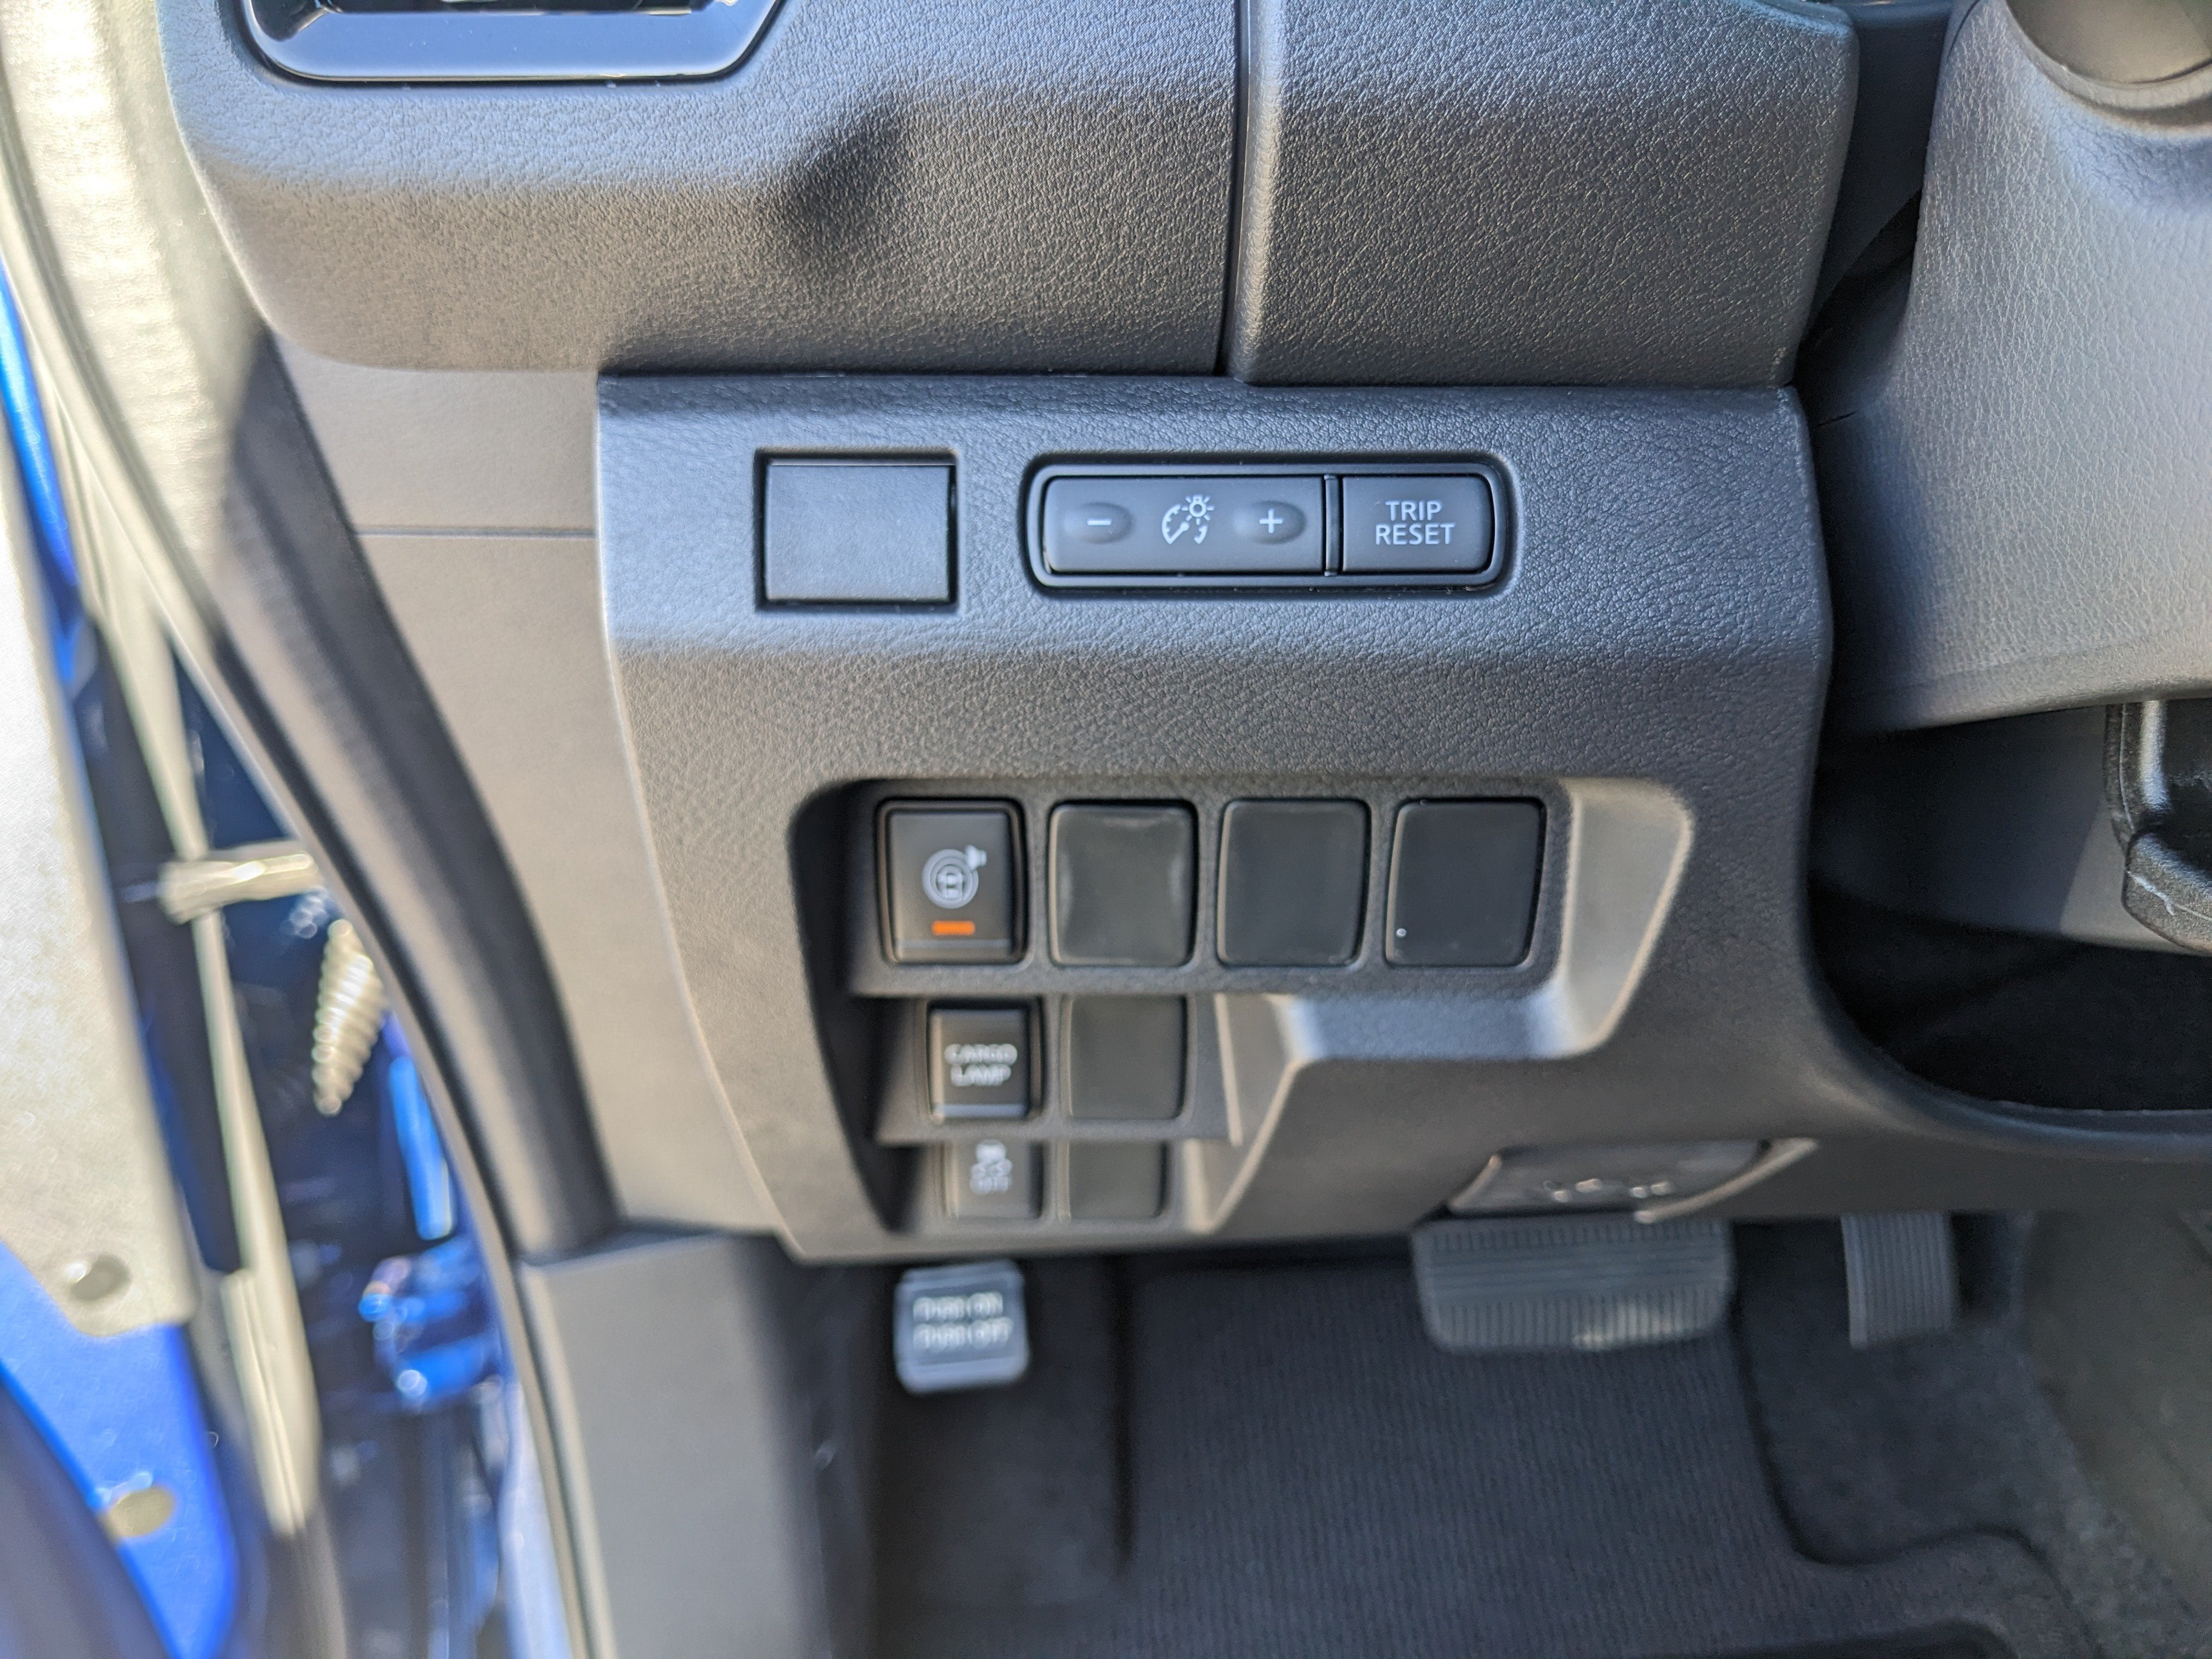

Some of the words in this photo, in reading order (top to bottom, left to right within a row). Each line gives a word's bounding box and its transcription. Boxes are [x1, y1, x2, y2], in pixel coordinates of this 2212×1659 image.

[1385, 500, 1442, 521] TRIP
[1375, 523, 1455, 545] RESET
[944, 1043, 1018, 1065] CARGO
[951, 1064, 1011, 1086] LAMP
